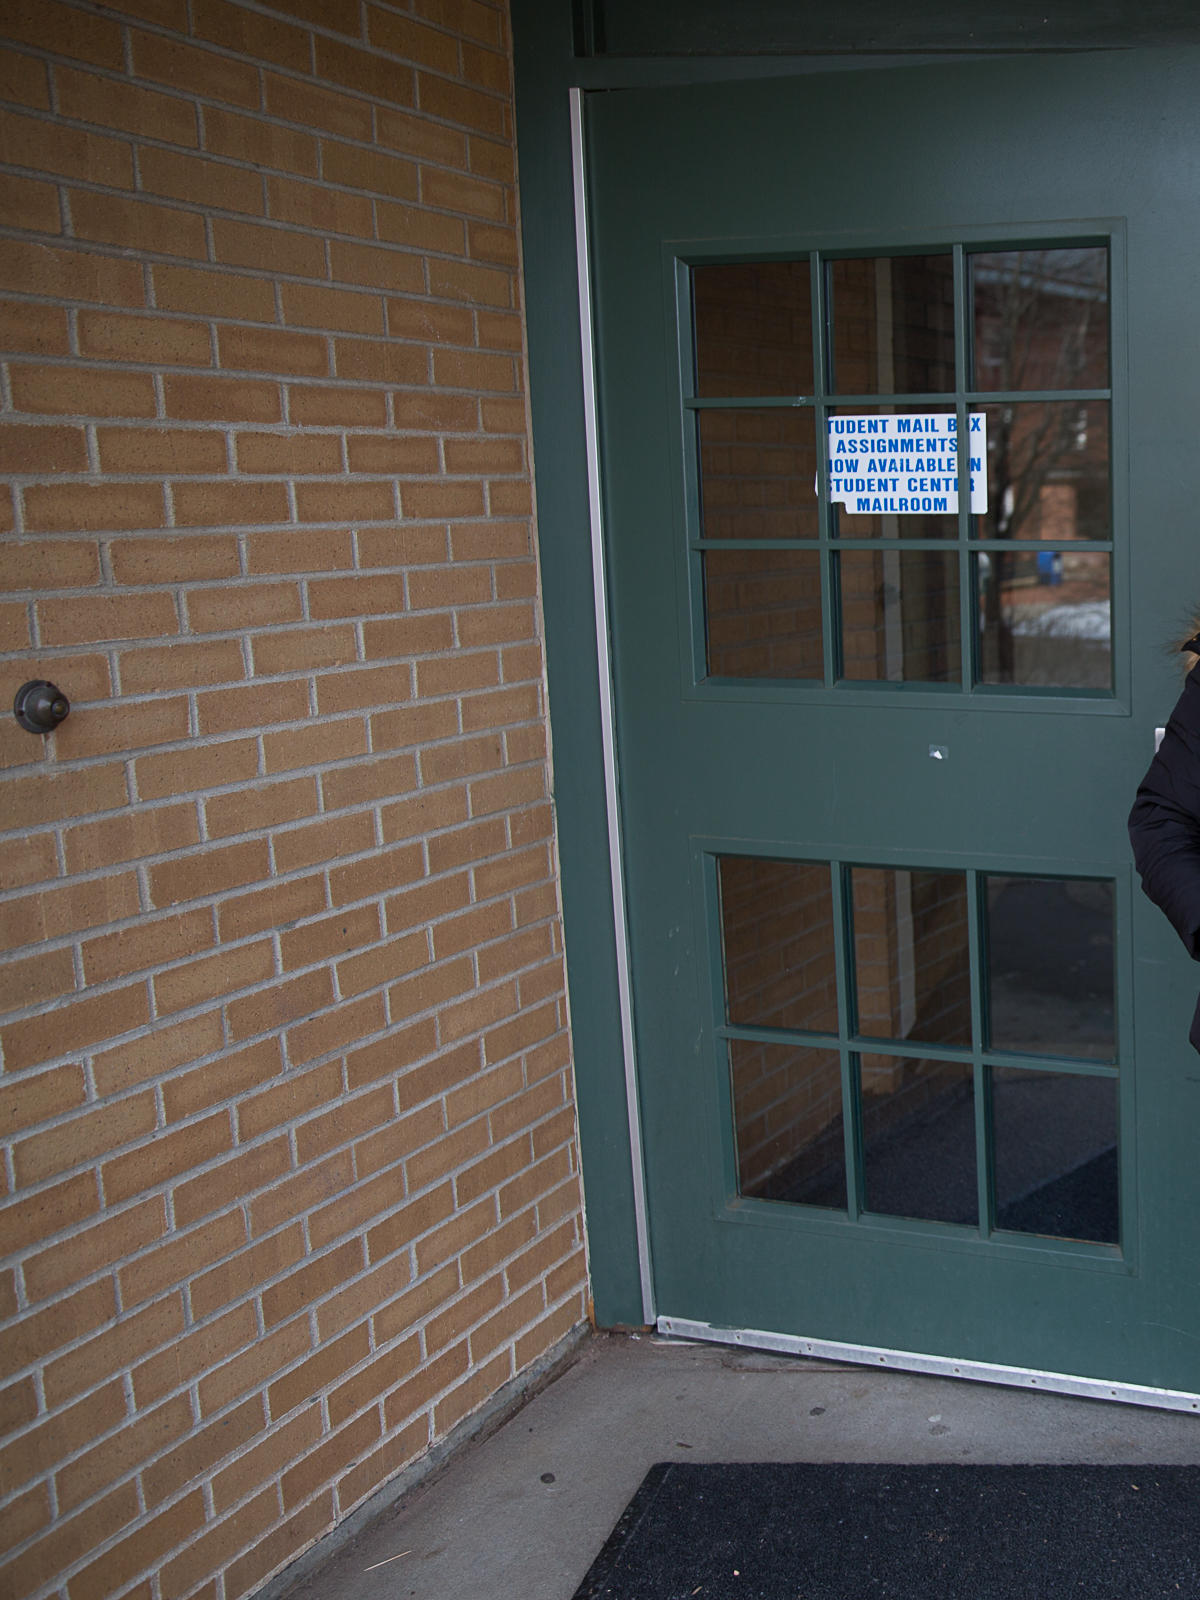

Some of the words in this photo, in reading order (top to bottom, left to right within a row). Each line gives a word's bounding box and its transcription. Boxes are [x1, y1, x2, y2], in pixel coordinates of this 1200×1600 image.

[828, 419, 889, 434] TUDENT
[897, 418, 939, 433] MAIL
[947, 417, 981, 432] BX
[836, 437, 958, 453] ASSIGNMENTS
[867, 457, 956, 473] AVAILABLE
[967, 457, 982, 472] N
[830, 478, 900, 492] TUDENT
[856, 497, 948, 512] MAILROOM
